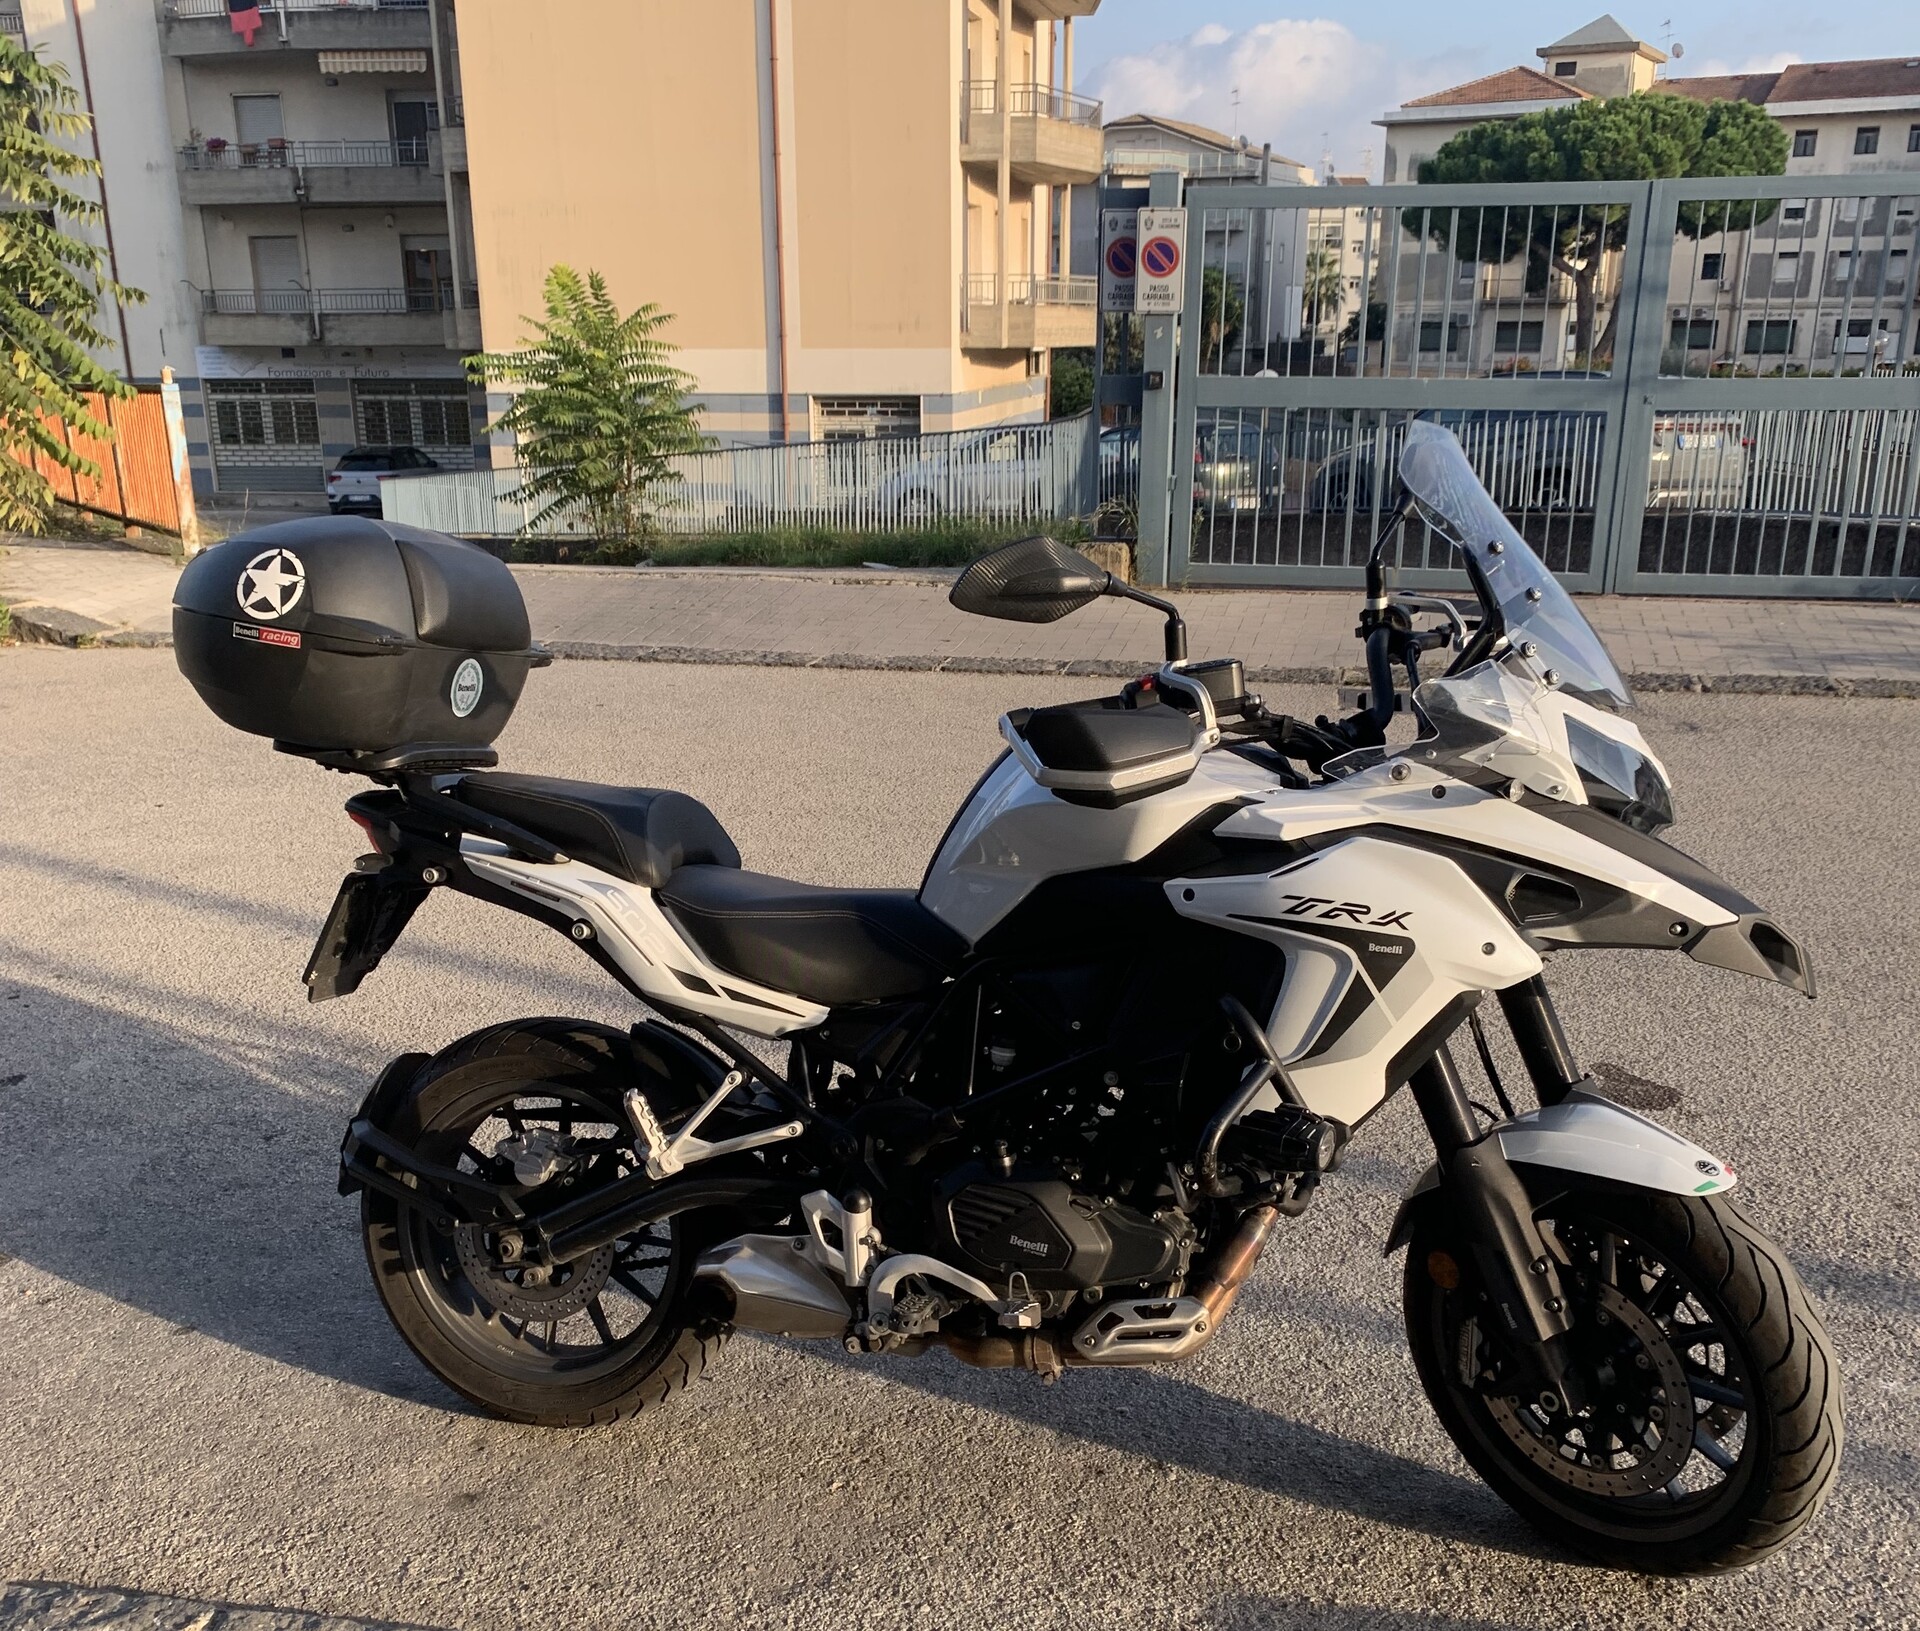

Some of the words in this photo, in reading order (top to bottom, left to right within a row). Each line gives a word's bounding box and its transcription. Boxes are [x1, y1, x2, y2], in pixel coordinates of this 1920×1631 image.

[1149, 284, 1169, 292] PASSO
[267, 366, 333, 378] Formazione
[340, 369, 346, 377] e
[354, 366, 390, 378] Futuro
[235, 626, 259, 638] Benelli
[262, 631, 299, 646] racing
[457, 683, 477, 692] Benelli
[1280, 894, 1414, 931] TRK
[1368, 942, 1403, 955] Benelli
[1009, 1234, 1049, 1254] Benelli
